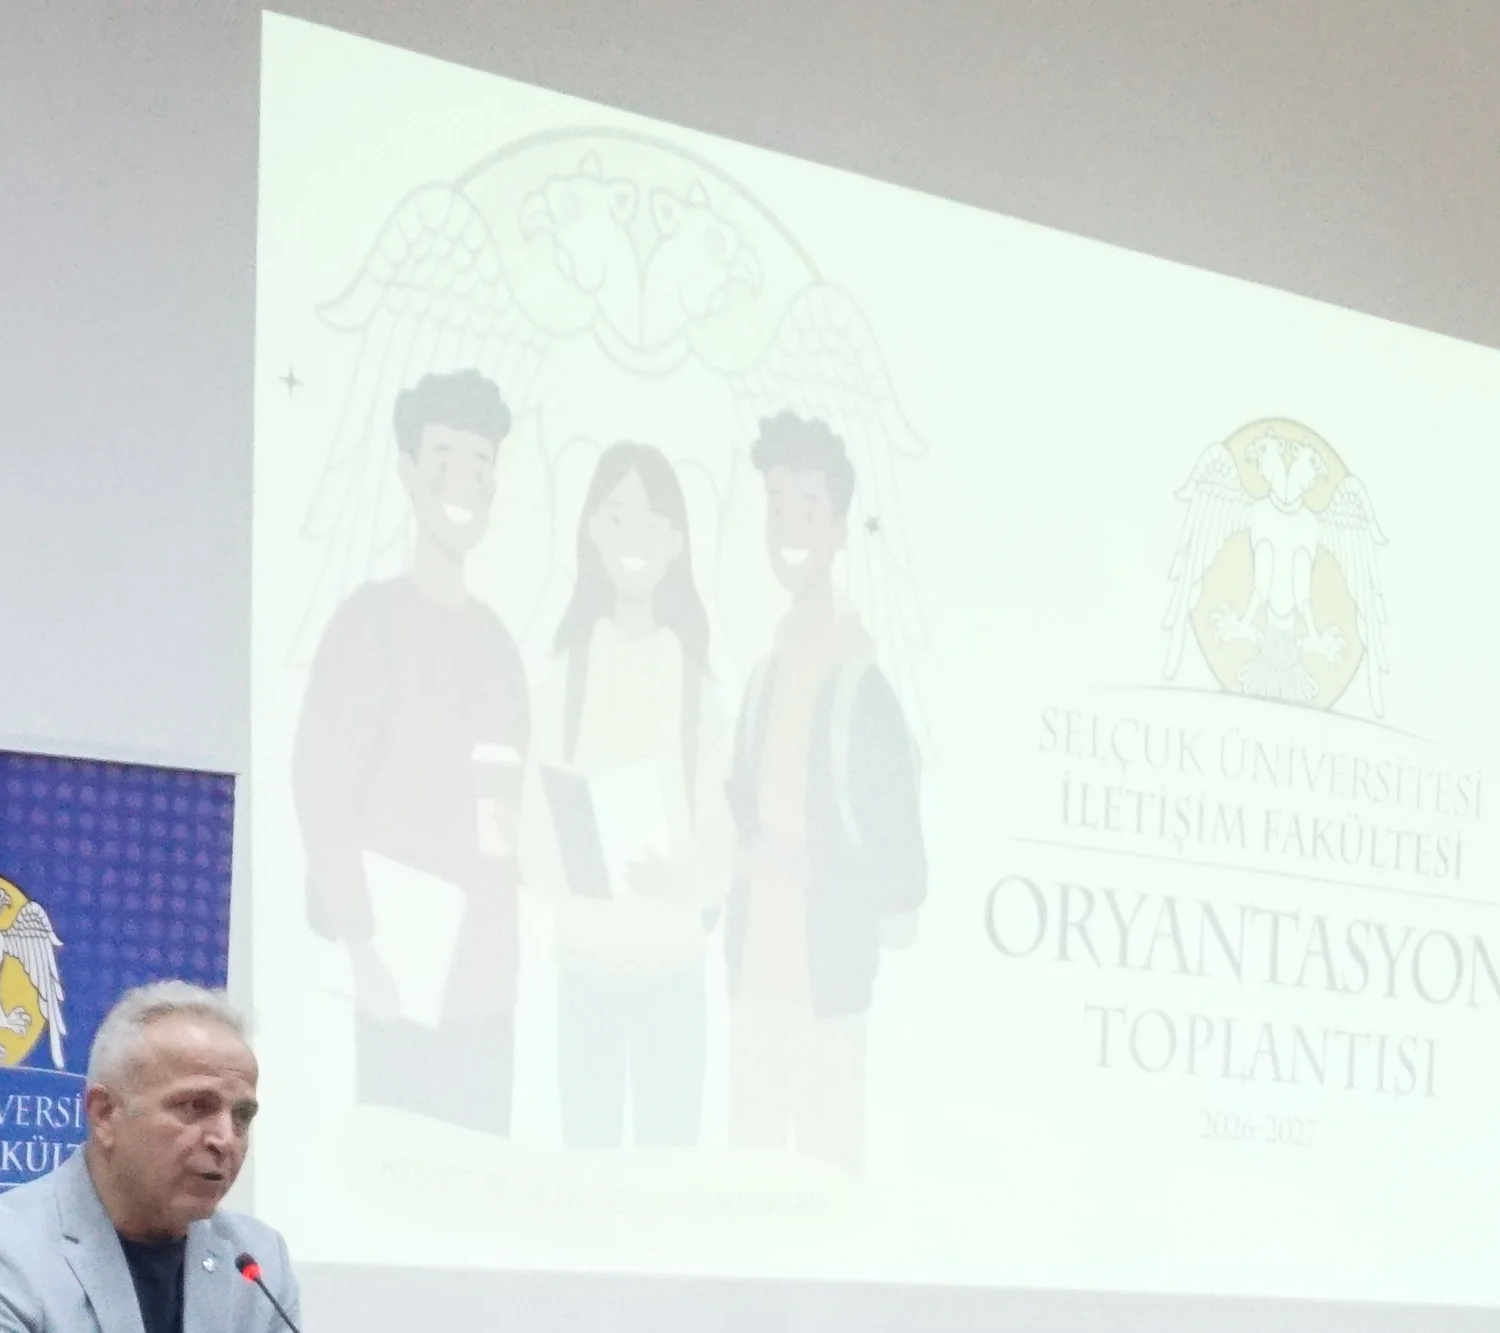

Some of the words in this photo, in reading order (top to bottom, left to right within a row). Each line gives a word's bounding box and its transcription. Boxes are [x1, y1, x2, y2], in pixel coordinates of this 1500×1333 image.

[1038, 706, 1206, 778] SELÇUK
[1219, 726, 1484, 820] ÜNİVERSİTESİ
[1060, 771, 1248, 853] İLETİŞİM
[1263, 808, 1465, 881] FAKÜLTESİ
[1084, 999, 1440, 1098] TOPLANTISI
[1198, 1107, 1318, 1147] 2026-2027
